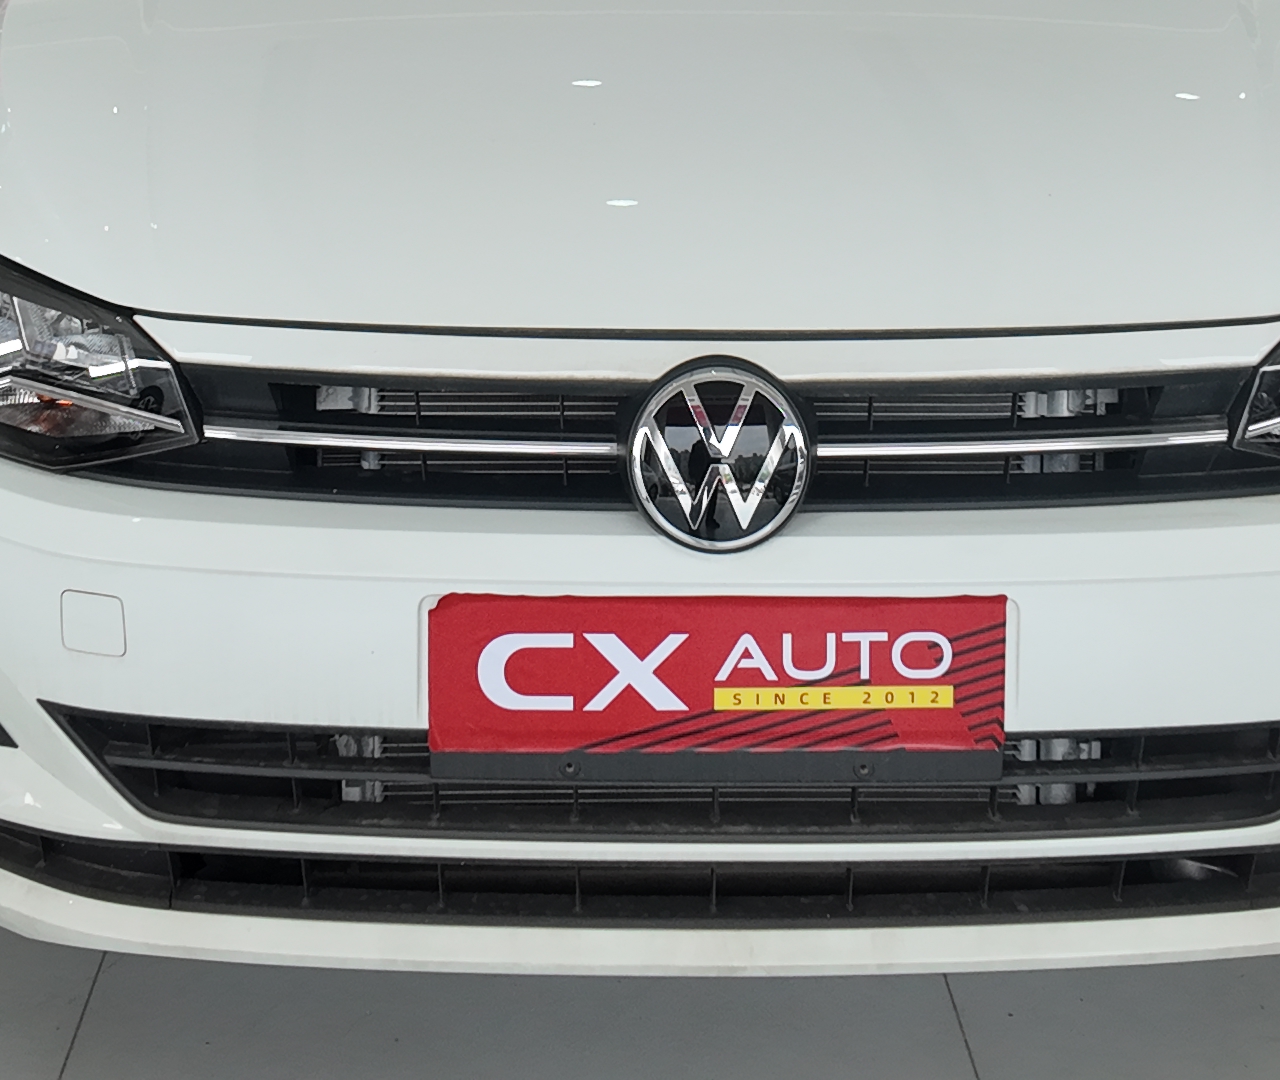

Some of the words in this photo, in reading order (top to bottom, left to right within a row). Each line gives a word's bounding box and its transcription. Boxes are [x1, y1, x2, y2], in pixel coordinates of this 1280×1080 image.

[477, 632, 690, 712] CX
[714, 631, 953, 682] AUTO
[731, 692, 834, 706] SINCE
[861, 691, 942, 705] 2012
